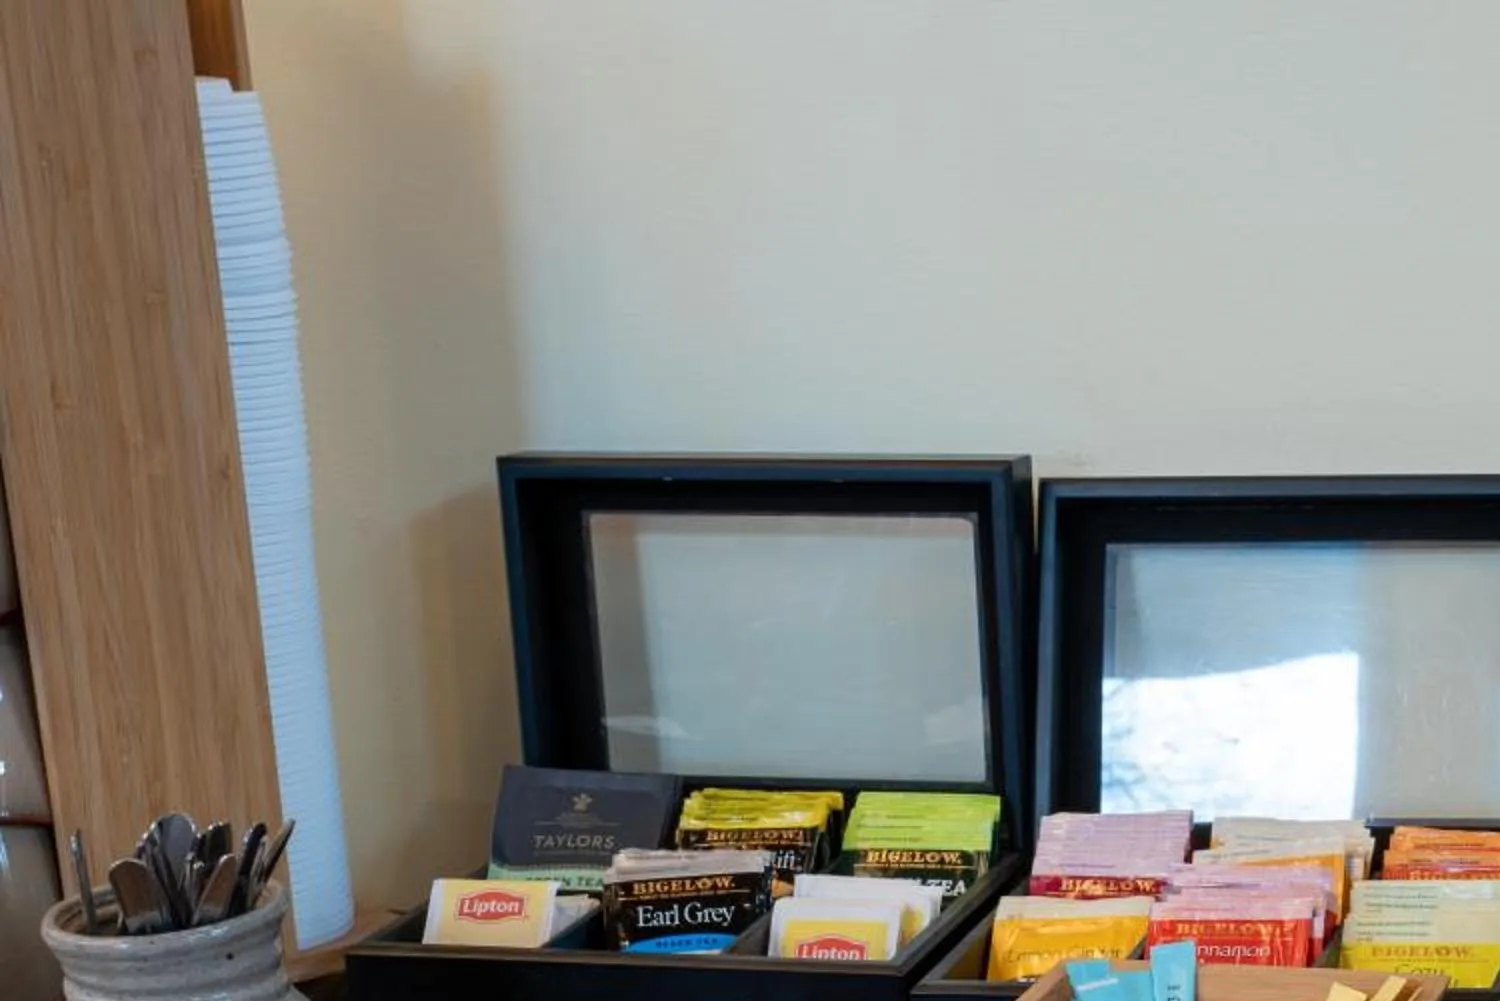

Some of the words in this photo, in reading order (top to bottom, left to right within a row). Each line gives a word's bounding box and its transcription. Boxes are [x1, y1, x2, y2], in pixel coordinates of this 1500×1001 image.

[533, 834, 616, 849] TAYLORS
[463, 898, 520, 917] Lipton
[636, 903, 681, 928] Earl
[683, 902, 735, 927] Grey
[802, 943, 860, 960] Lipton
